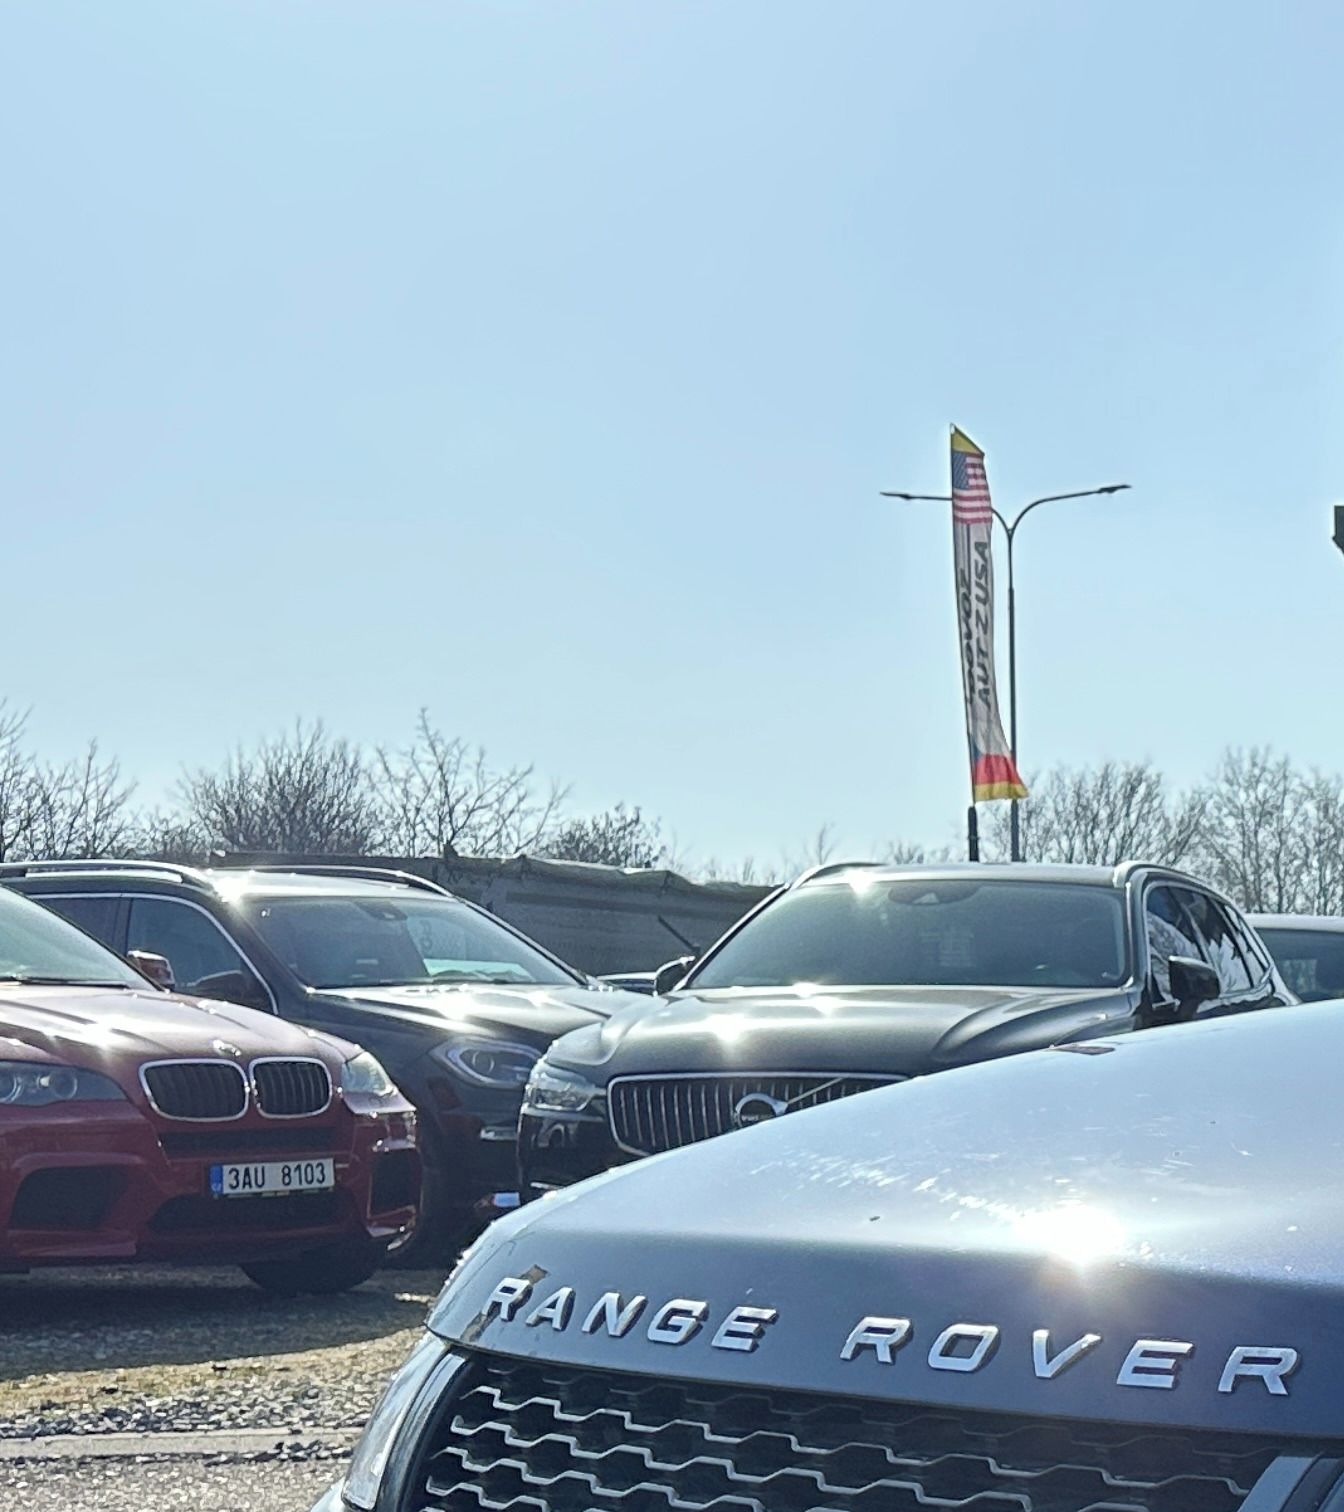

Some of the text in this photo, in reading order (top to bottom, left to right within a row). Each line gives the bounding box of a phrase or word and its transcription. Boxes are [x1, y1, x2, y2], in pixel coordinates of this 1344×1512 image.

[974, 541, 988, 606] USA
[228, 1162, 326, 1190] 3AU 8103
[482, 1276, 1300, 1397] RANGE ROVER
